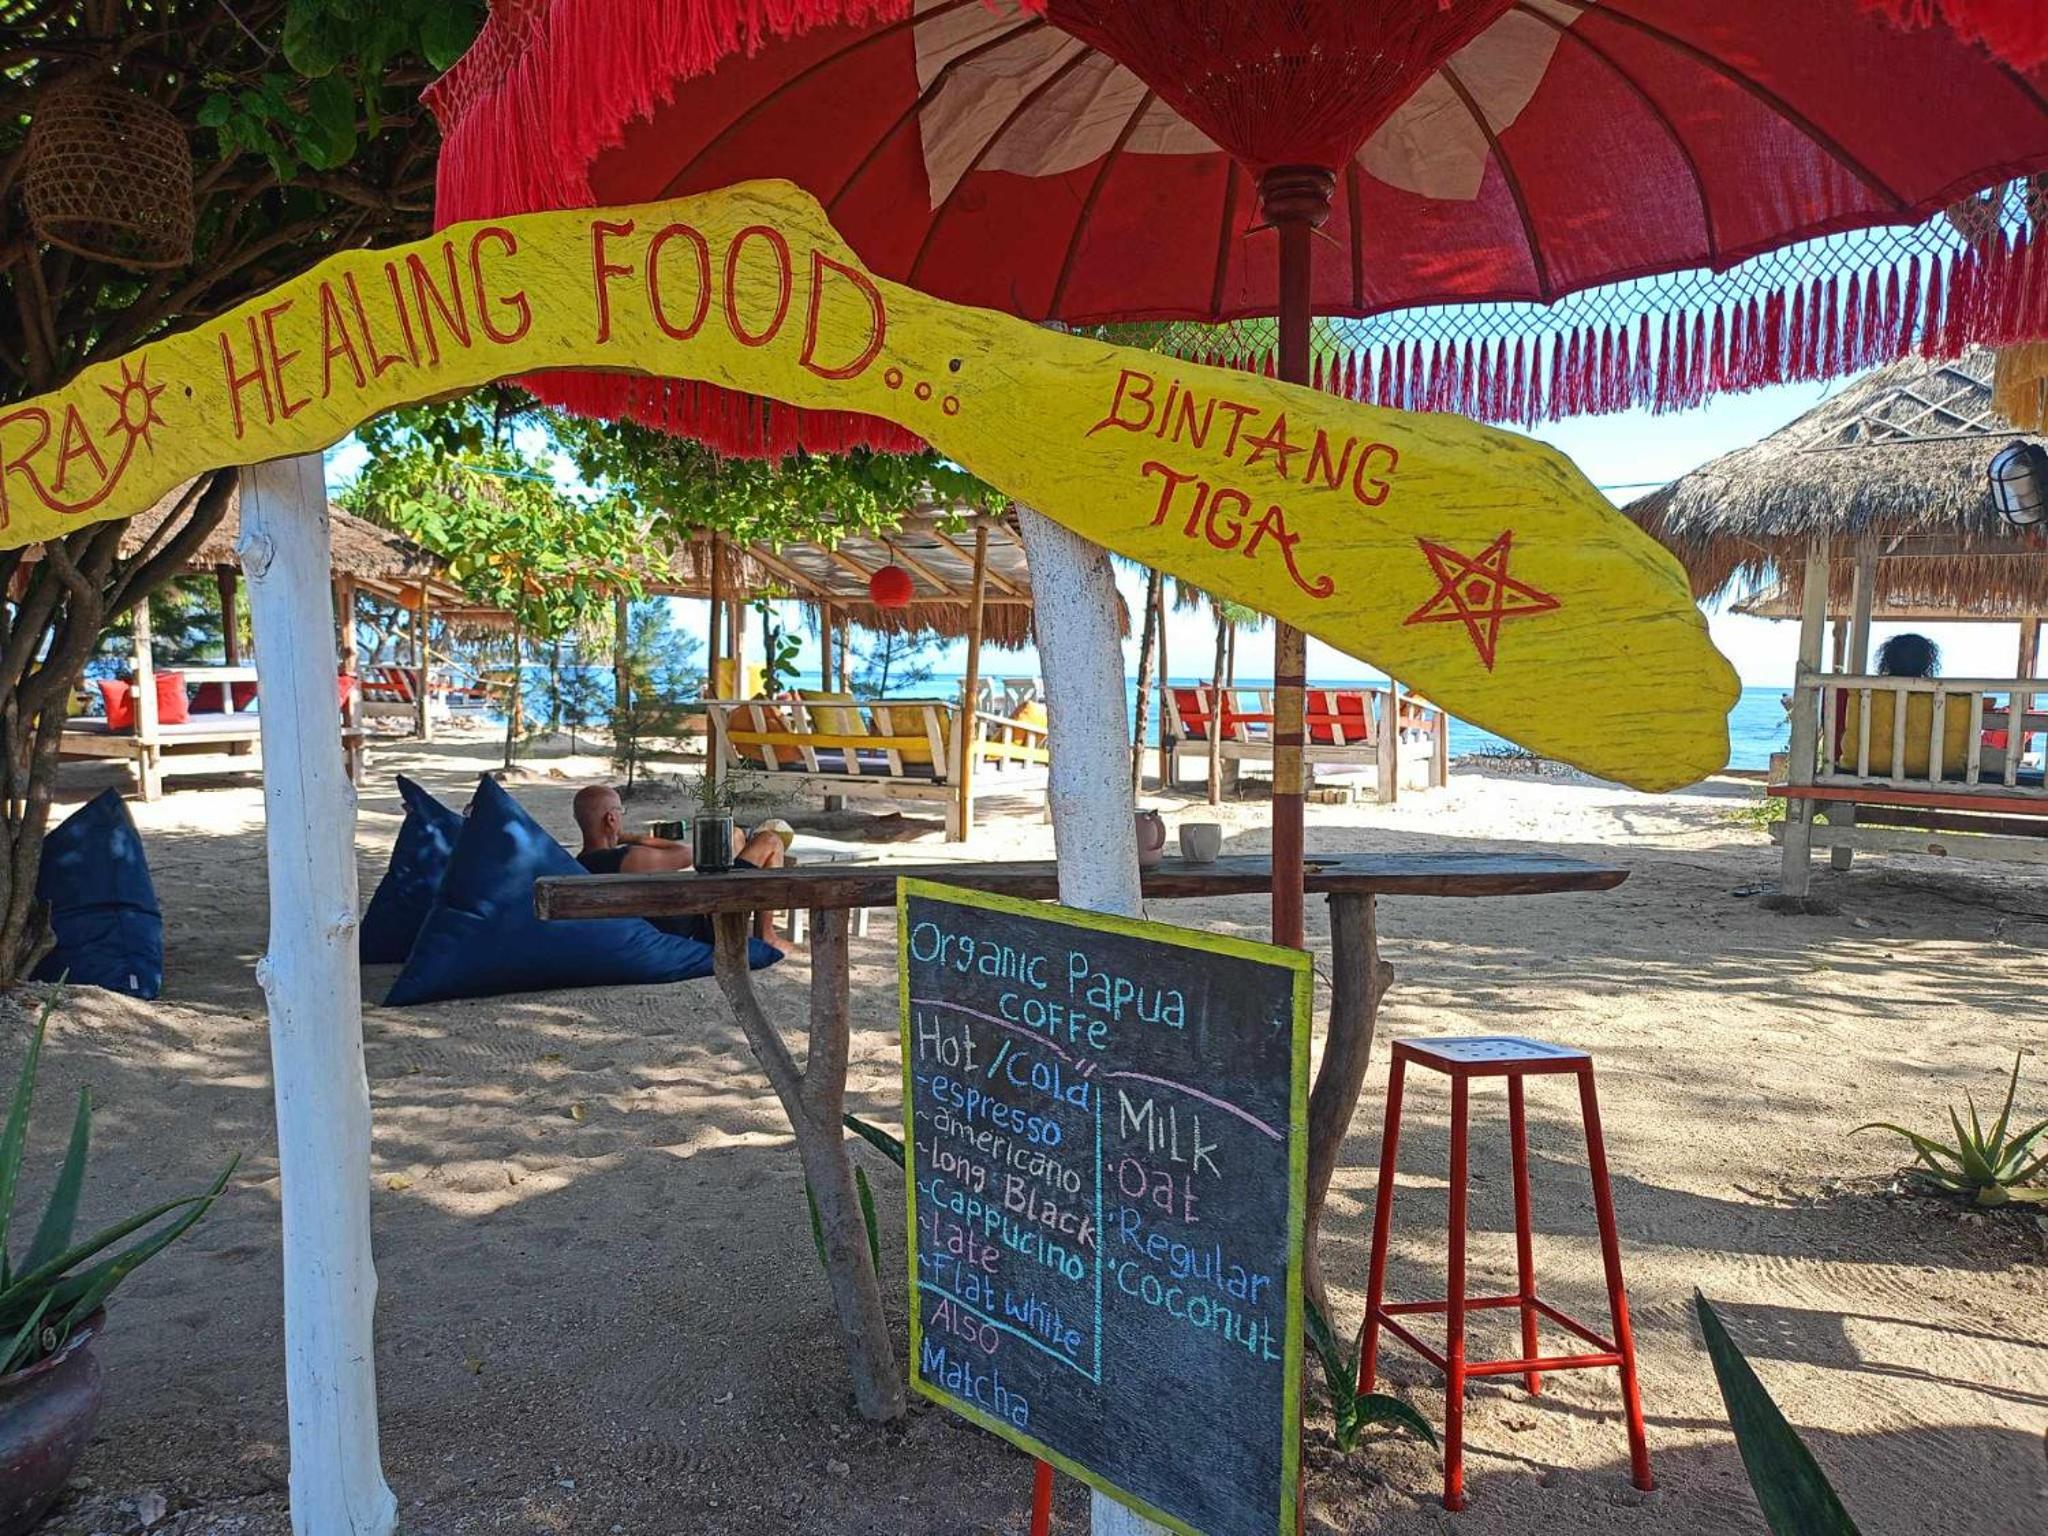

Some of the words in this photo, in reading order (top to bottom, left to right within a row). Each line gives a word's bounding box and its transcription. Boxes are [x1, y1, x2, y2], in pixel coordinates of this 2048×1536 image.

[218, 226, 532, 438] HEALING
[1142, 460, 1335, 599] TIGA
[911, 922, 1047, 990] Organic
[1069, 950, 1185, 1029] Papua
[918, 1012, 979, 1072] Hot
[922, 1336, 1029, 1428] Matcha
